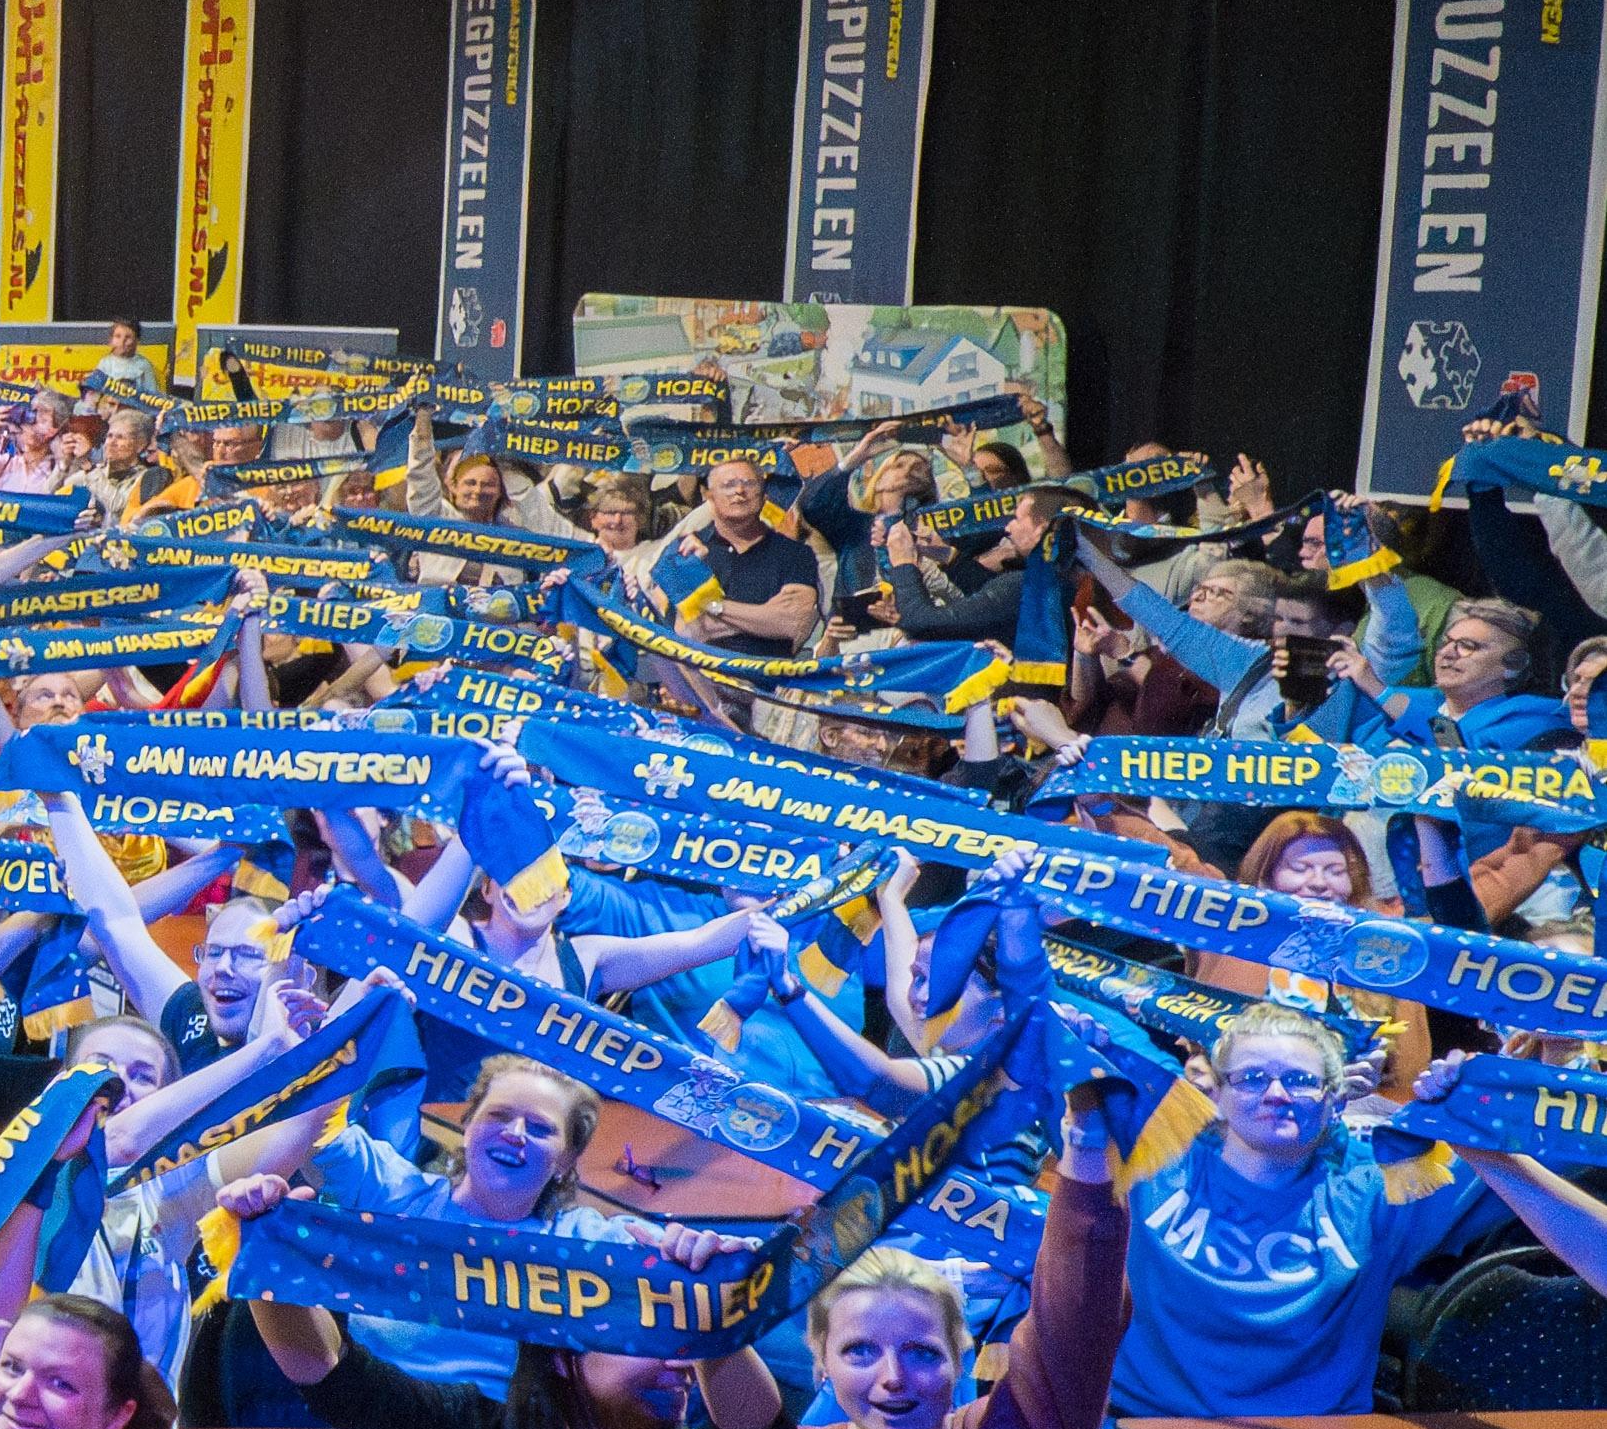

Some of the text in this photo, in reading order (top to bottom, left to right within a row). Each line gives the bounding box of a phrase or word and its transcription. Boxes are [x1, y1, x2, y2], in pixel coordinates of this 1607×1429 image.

[237, 401, 283, 419] HIEP
[507, 433, 620, 461] HIEP HIEP
[691, 448, 776, 466] HOERA
[349, 515, 568, 562] JAN VAN HAASTEREN
[147, 548, 370, 580] JAN HAASTEREN
[298, 602, 371, 629] HIEP
[127, 745, 430, 786] JAN VAN HAASTEREN
[1122, 750, 1320, 785] HIEP HIEP
[782, 798, 827, 824] VAN
[673, 833, 820, 880] HOERA
[1130, 877, 1268, 932] HIEP
[405, 943, 664, 1075] HIEP HIEP
[453, 1253, 774, 1331] HIEP HIEP
